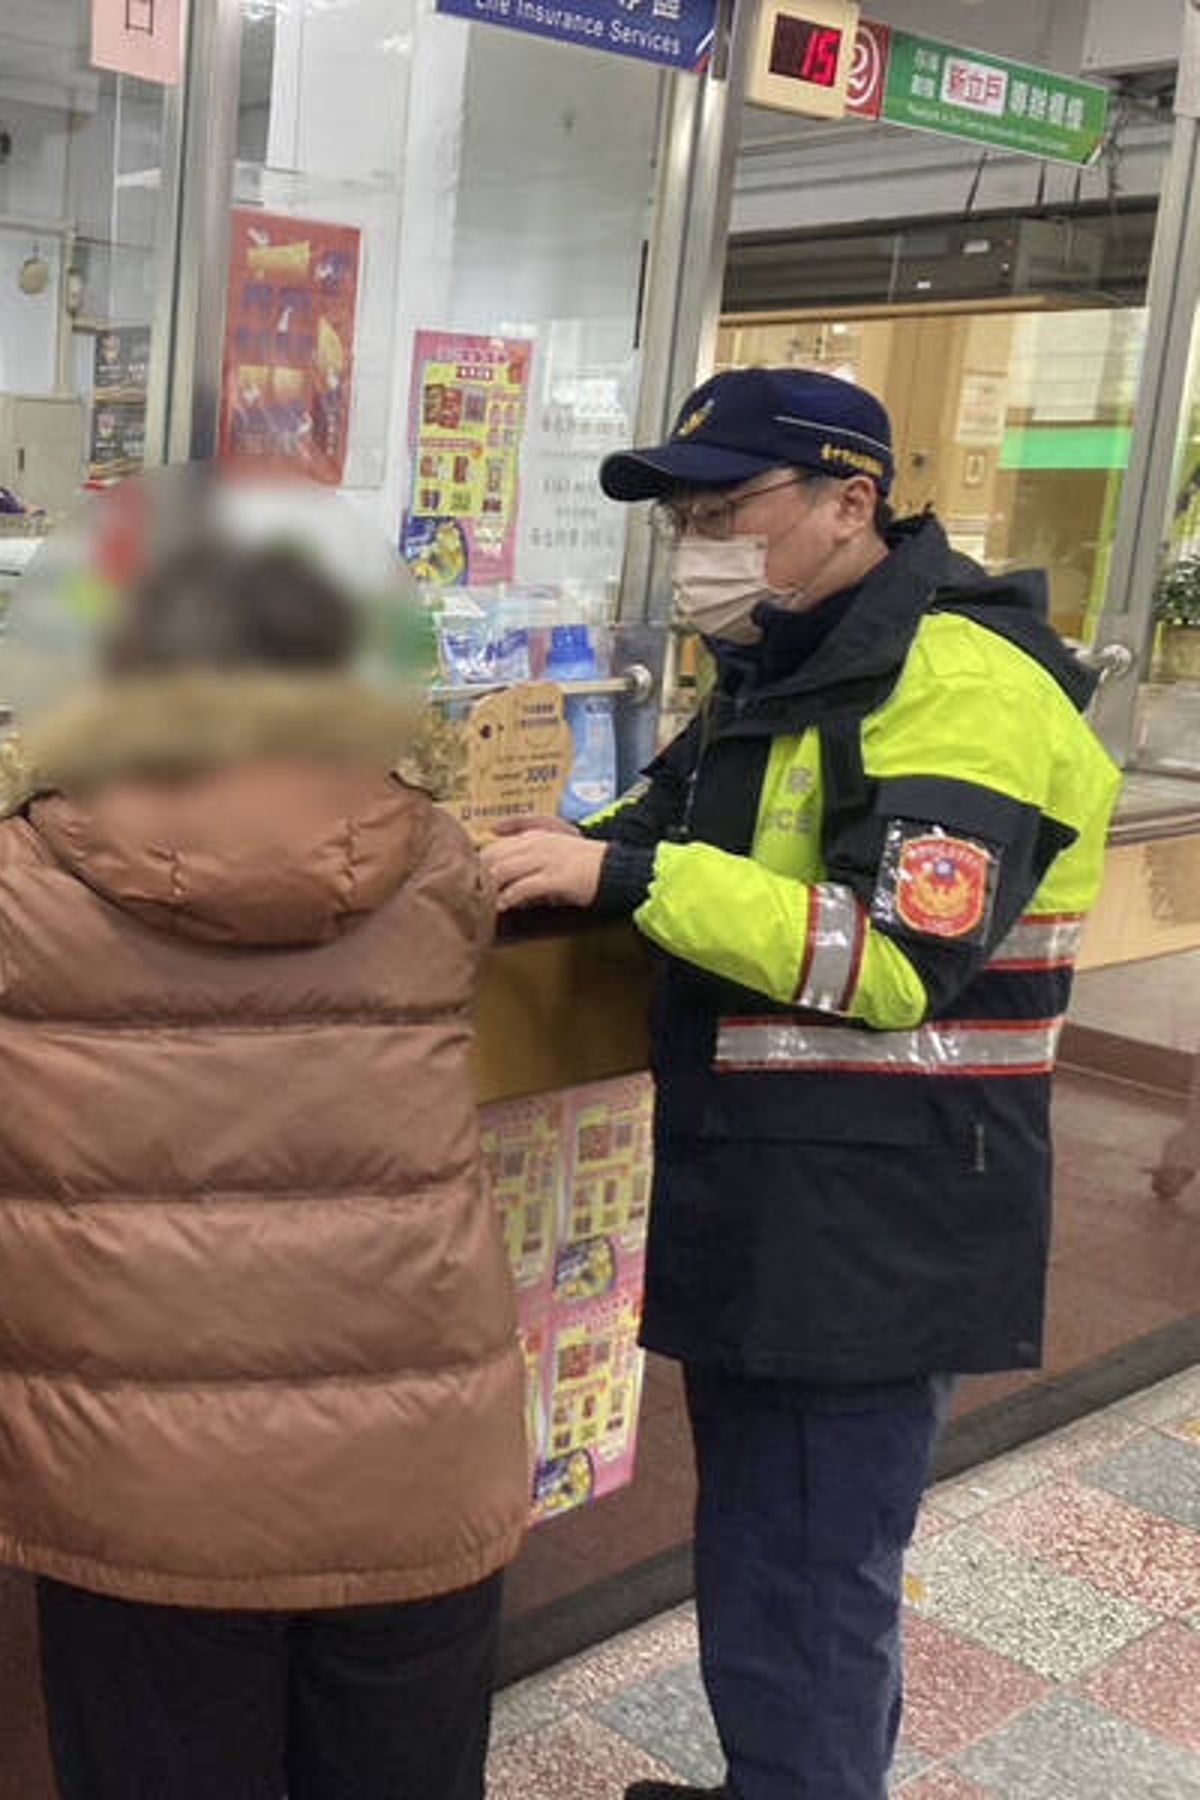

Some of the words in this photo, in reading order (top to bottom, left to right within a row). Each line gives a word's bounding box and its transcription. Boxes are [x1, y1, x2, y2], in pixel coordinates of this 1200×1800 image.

[517, 0, 604, 38] Insurance
[608, 19, 681, 56] Services
[801, 29, 841, 86] 15
